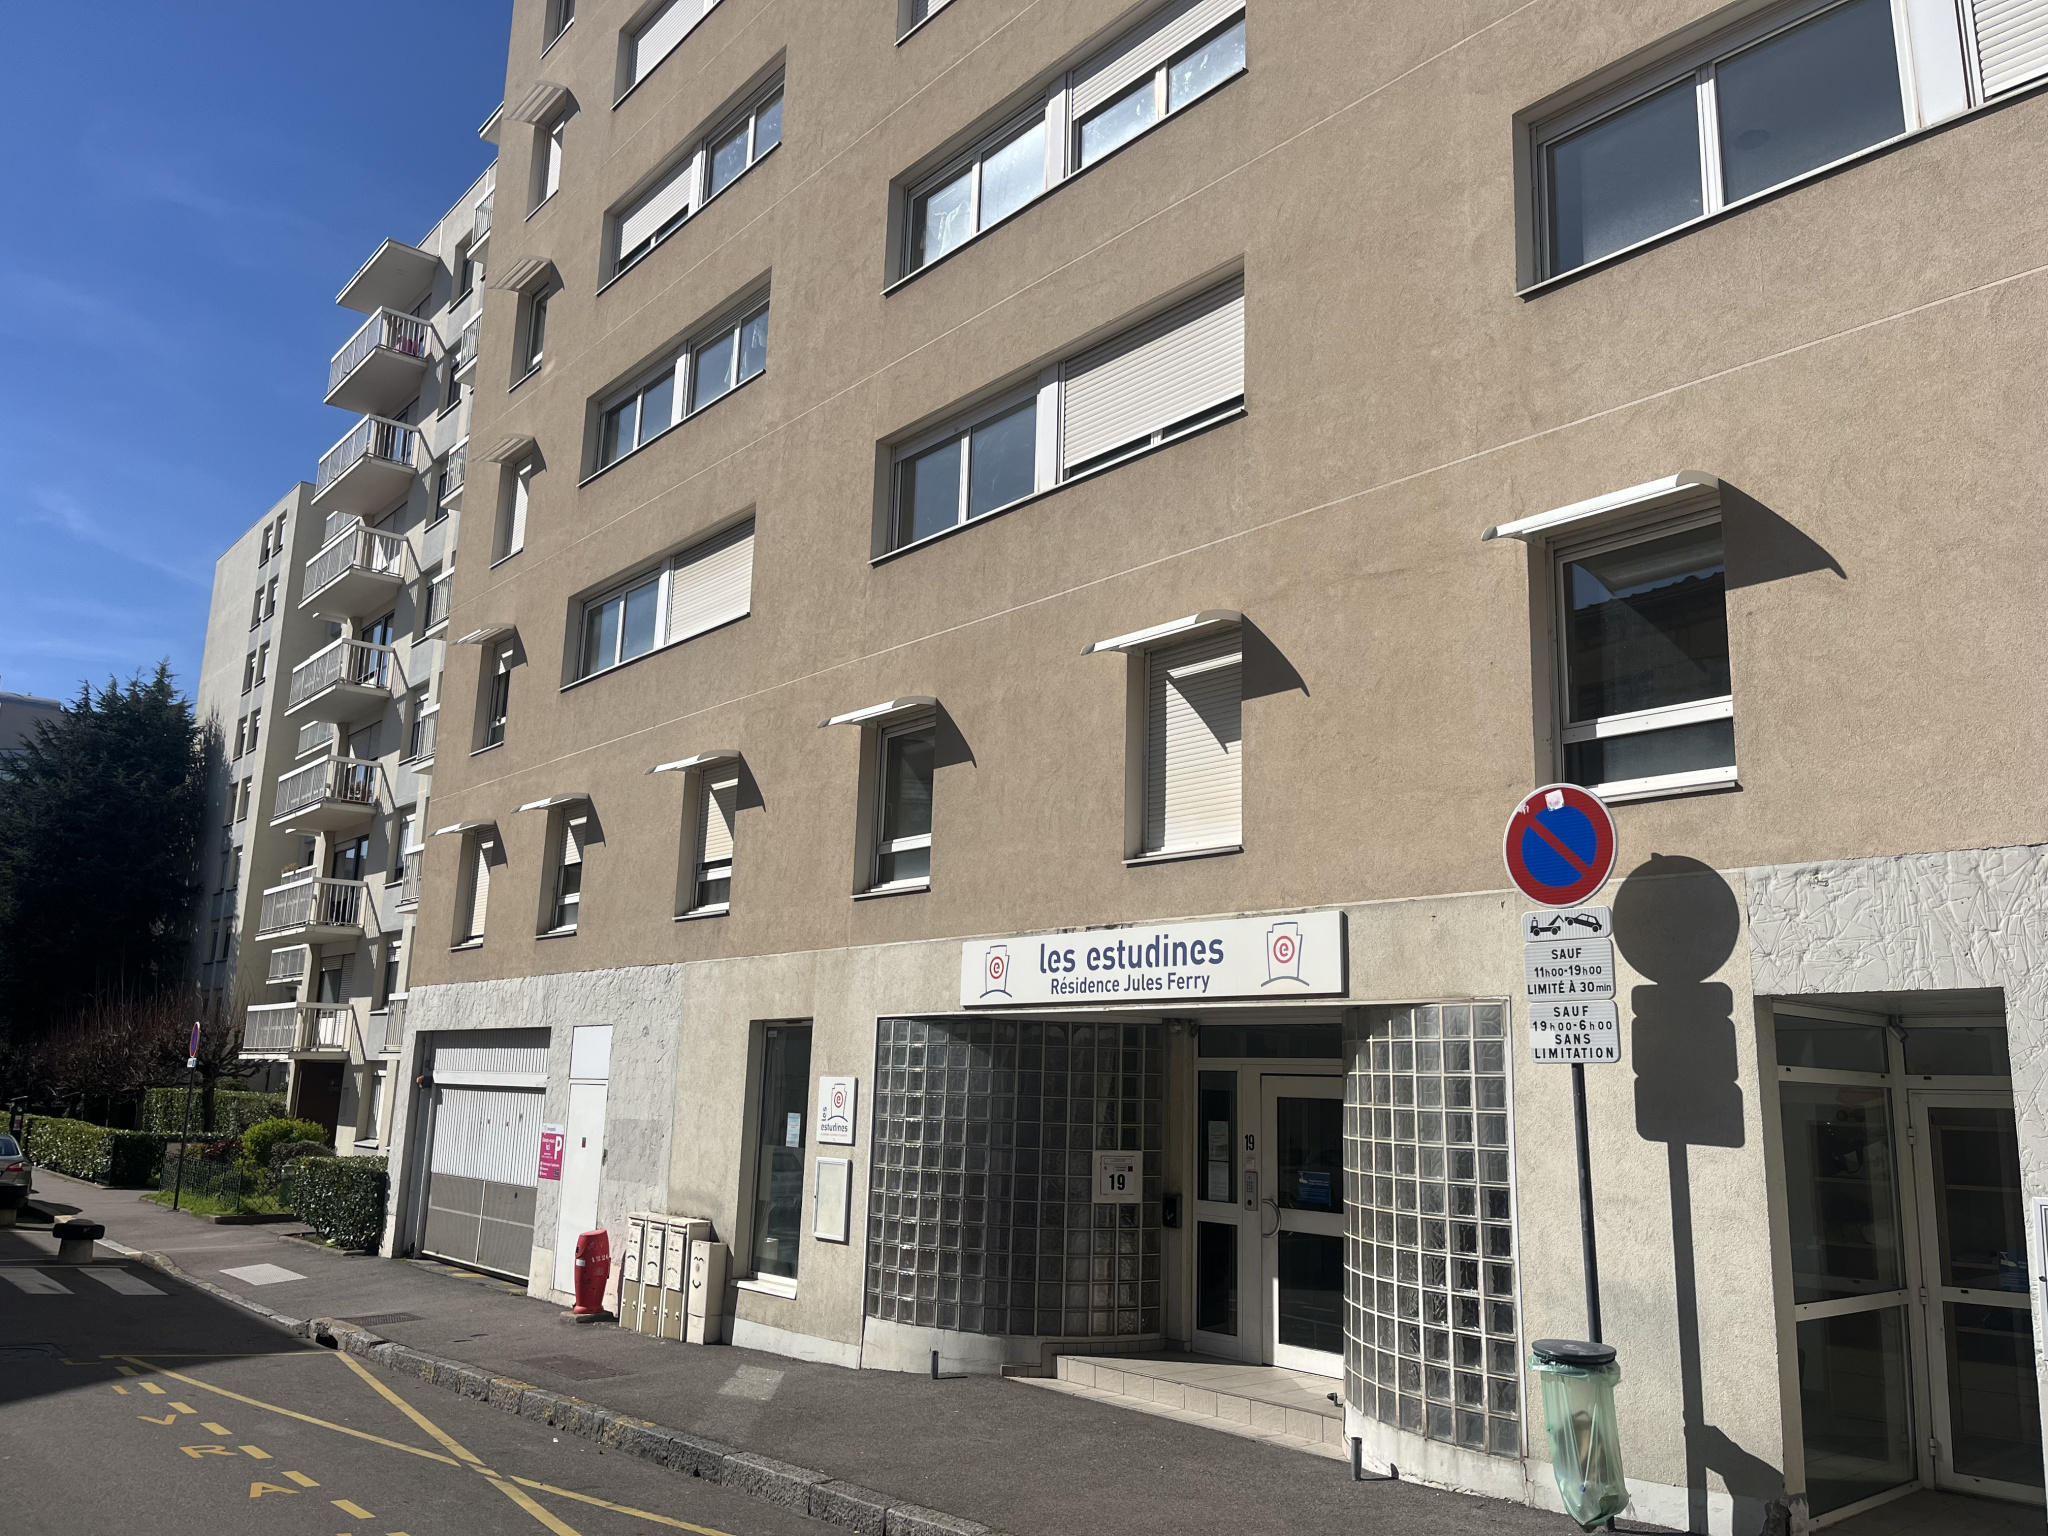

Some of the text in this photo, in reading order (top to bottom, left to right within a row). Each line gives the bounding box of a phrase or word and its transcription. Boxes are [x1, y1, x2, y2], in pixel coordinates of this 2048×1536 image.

[1040, 934, 1224, 973] les estudines
[1551, 947, 1582, 960] SAUF
[1534, 965, 1602, 977] 11h00-19h00
[1051, 972, 1210, 995] Résidence Jules Ferry
[1527, 980, 1565, 995] LIMITÉ
[1569, 980, 1576, 993] À
[1553, 1005, 1588, 1017] SAUF
[1555, 1033, 1591, 1045] SANS
[1535, 1047, 1614, 1059] LIMITATION
[821, 1123, 848, 1132] estudines
[553, 1135, 563, 1160] P
[1244, 1134, 1255, 1151] 19
[1109, 1174, 1126, 1190] 19
